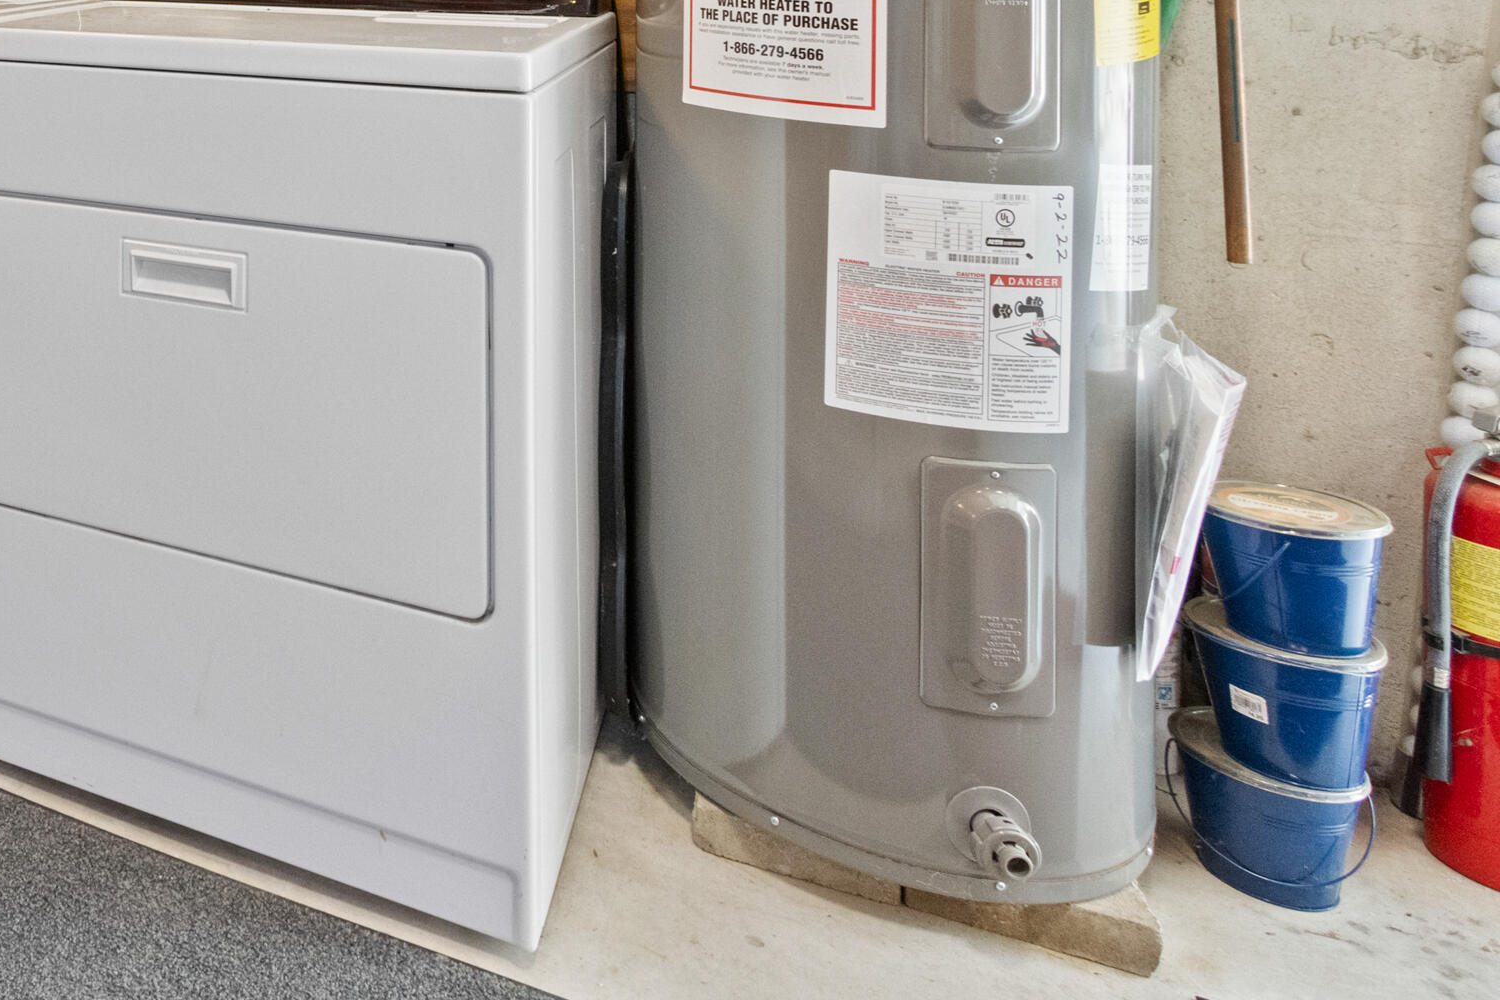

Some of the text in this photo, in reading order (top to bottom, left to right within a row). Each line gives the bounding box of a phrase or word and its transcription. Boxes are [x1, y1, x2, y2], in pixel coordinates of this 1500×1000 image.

[815, 1, 833, 14] TO
[700, 7, 859, 31] THE PLACE OF PURCHASE
[723, 41, 824, 61] 1-866-279-4566
[1052, 193, 1068, 264] 9-2-22
[1008, 277, 1059, 287] DANGER
